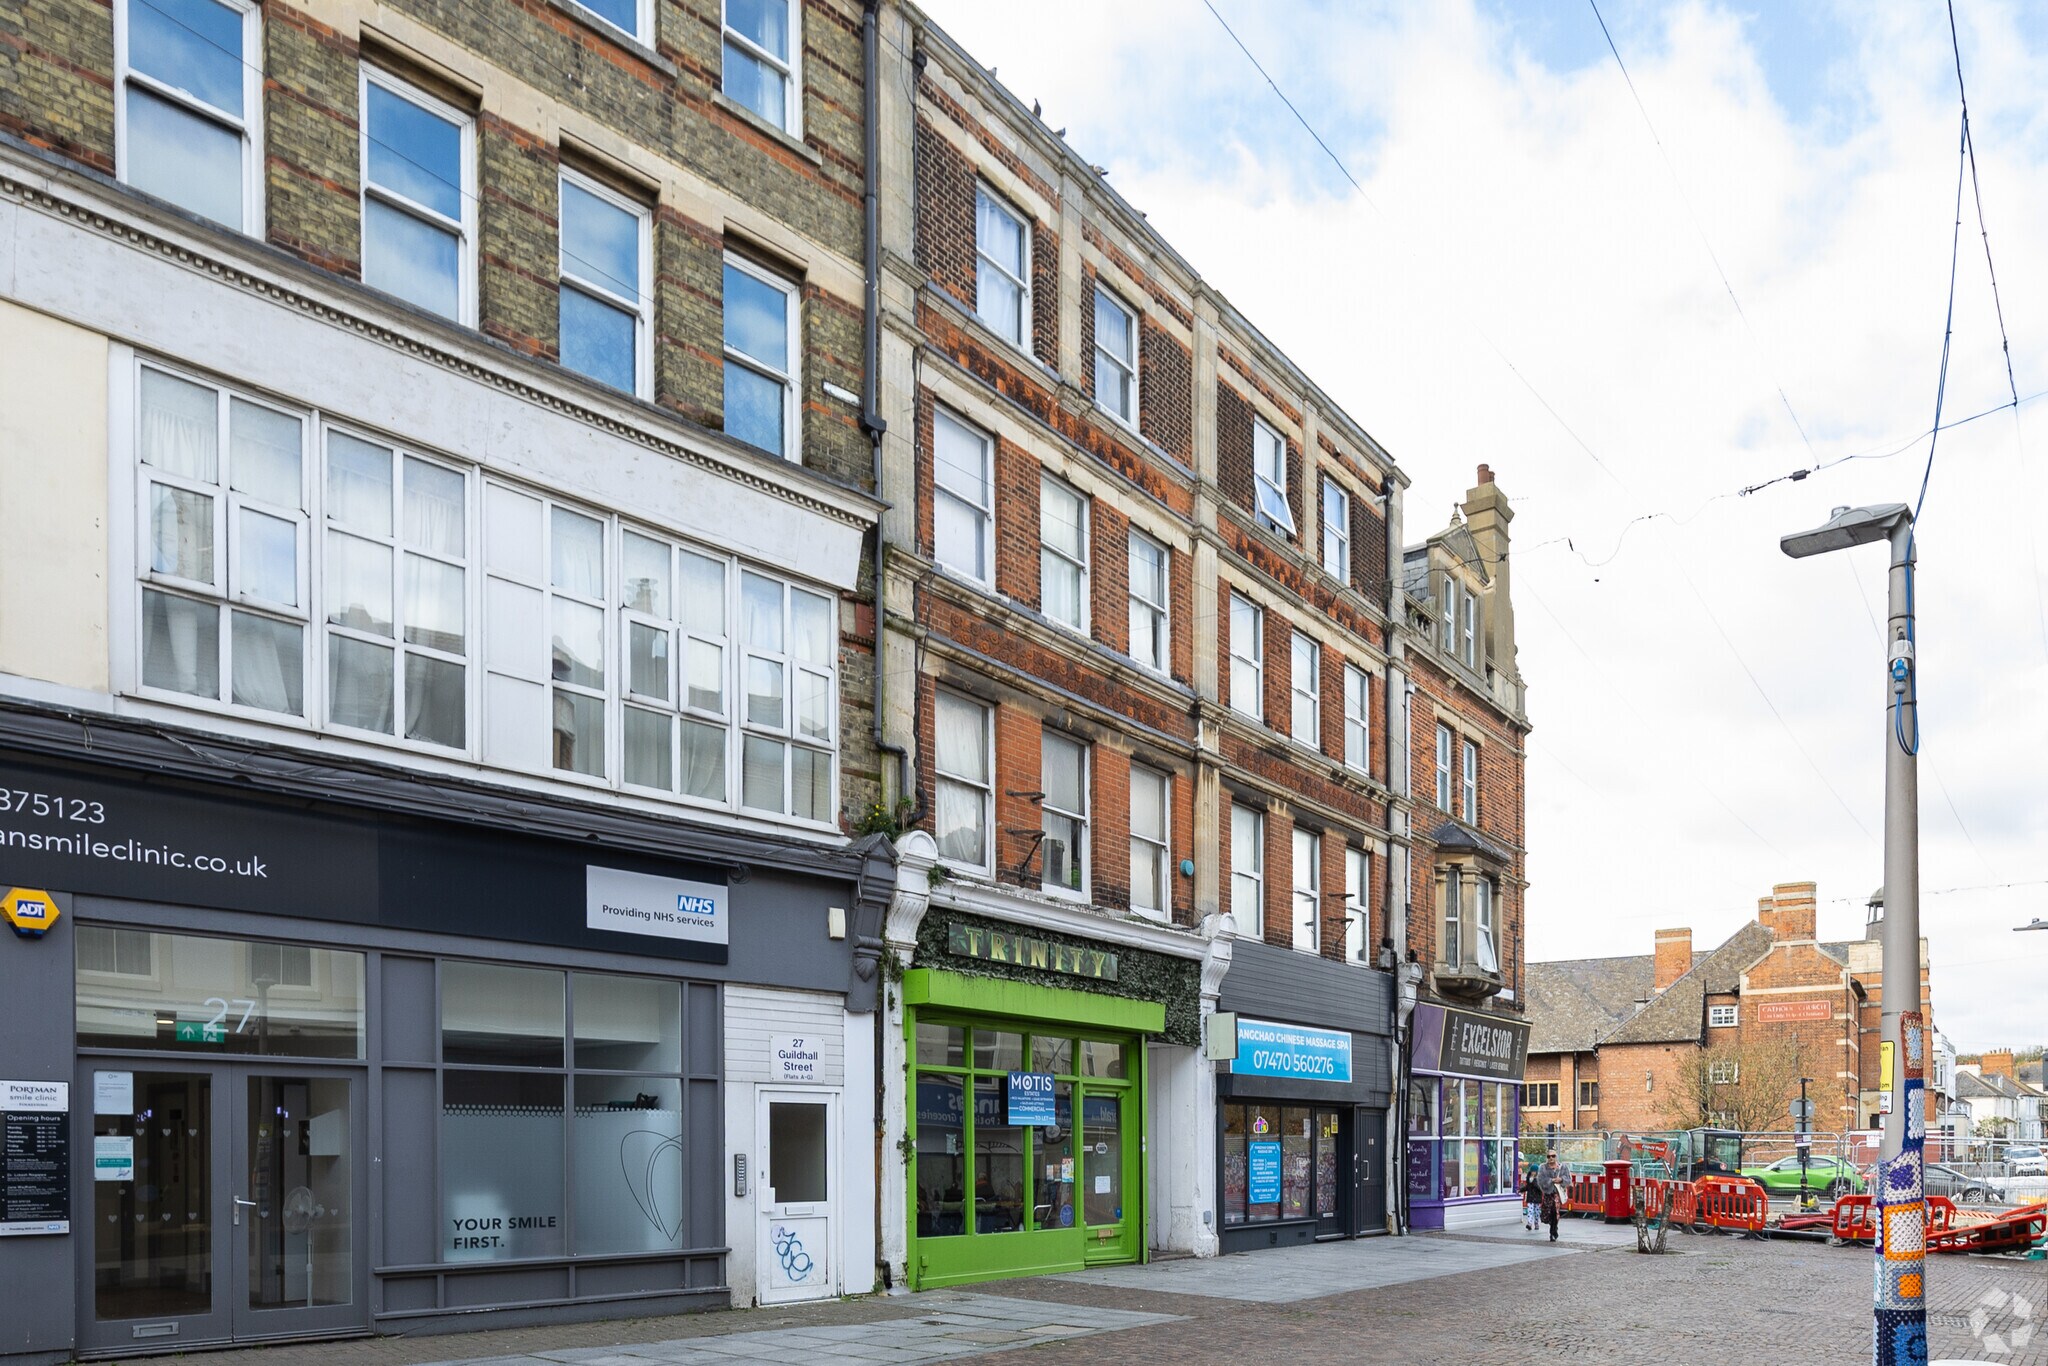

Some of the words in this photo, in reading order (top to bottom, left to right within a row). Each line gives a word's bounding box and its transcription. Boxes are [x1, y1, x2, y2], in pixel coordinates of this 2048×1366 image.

[17, 903, 45, 916] ADT
[679, 896, 713, 914] NHS
[602, 905, 651, 921] Providing
[653, 912, 674, 922] NHS
[677, 915, 715, 927] services
[965, 927, 1106, 977] TRINITY
[203, 997, 256, 1033] 27
[792, 1038, 804, 1048] 27
[1238, 1028, 1275, 1042] ANGCHAO
[1276, 1033, 1305, 1046] CHINESE
[1305, 1037, 1336, 1049] MASSAGE
[1337, 1040, 1349, 1051] SPA
[1461, 1022, 1513, 1059] EXCELSIOR
[778, 1049, 818, 1061] Guildhall
[1253, 1050, 1291, 1071] 07470
[1293, 1054, 1334, 1075] 560276
[783, 1061, 813, 1072] Street
[10, 1085, 57, 1094] PORTMAN
[1011, 1074, 1053, 1092] MOTIS
[7, 1114, 39, 1122] Opening
[1324, 1126, 1331, 1138] 31
[453, 1218, 502, 1231] YOUR
[508, 1216, 557, 1229] SMILE
[453, 1236, 505, 1250] FIRST.
